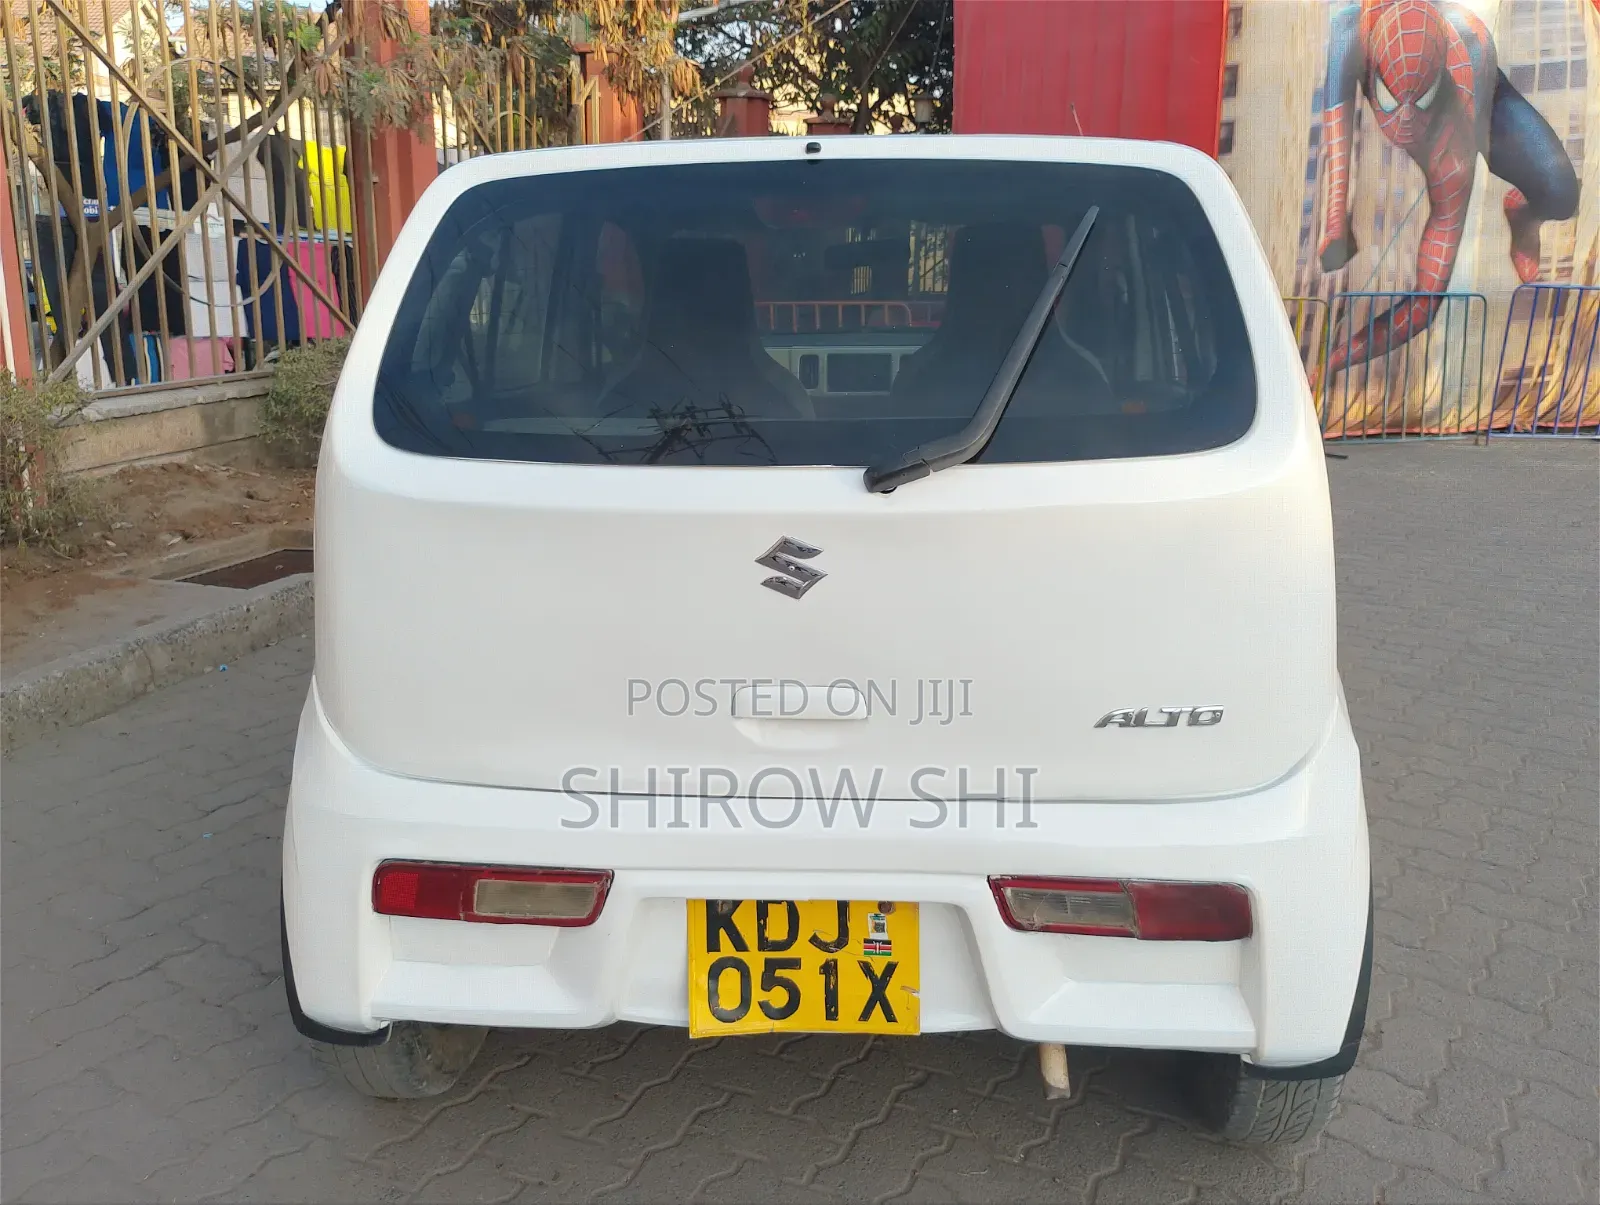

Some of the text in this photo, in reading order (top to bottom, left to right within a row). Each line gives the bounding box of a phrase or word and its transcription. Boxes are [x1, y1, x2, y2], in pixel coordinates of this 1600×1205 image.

[1093, 705, 1225, 728] ALTO
[705, 900, 850, 953] KDJ
[707, 956, 899, 1023] 051X
